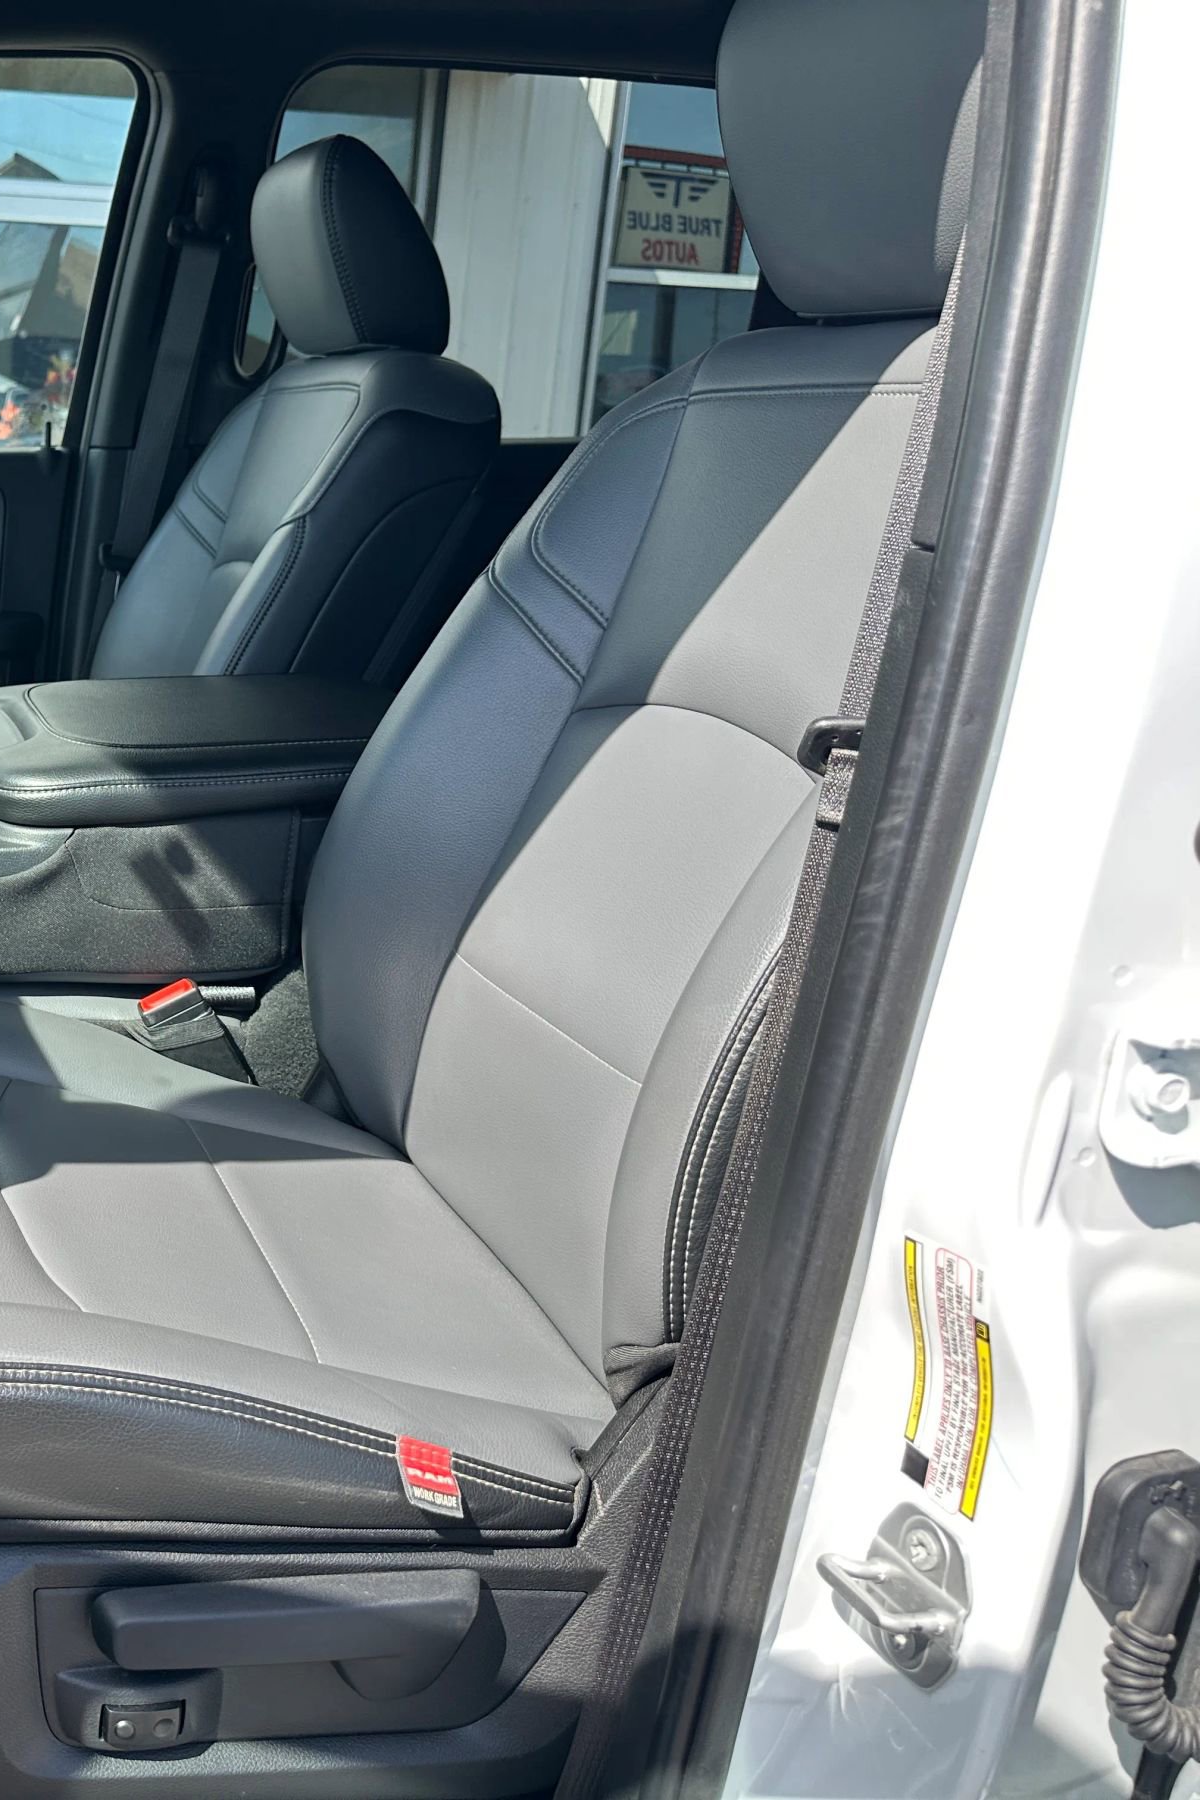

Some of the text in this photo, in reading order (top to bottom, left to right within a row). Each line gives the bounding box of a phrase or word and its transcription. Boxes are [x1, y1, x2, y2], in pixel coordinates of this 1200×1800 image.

[936, 1266, 945, 1294] PRIOR
[946, 1257, 955, 1284] (FSM)
[955, 1283, 963, 1311] LABEL
[946, 1285, 959, 1357] MANUFACTURER
[943, 1370, 952, 1397] ONLY
[951, 1387, 960, 1414] FINAL
[938, 1397, 951, 1436] APPLIES
[948, 1417, 957, 1430] BY
[967, 1406, 976, 1426] FOR
[930, 1435, 946, 1464] LABEL
[928, 1465, 939, 1487] THIS
[937, 1460, 949, 1486] FINAL
[412, 1485, 457, 1508] WORK GRADE
